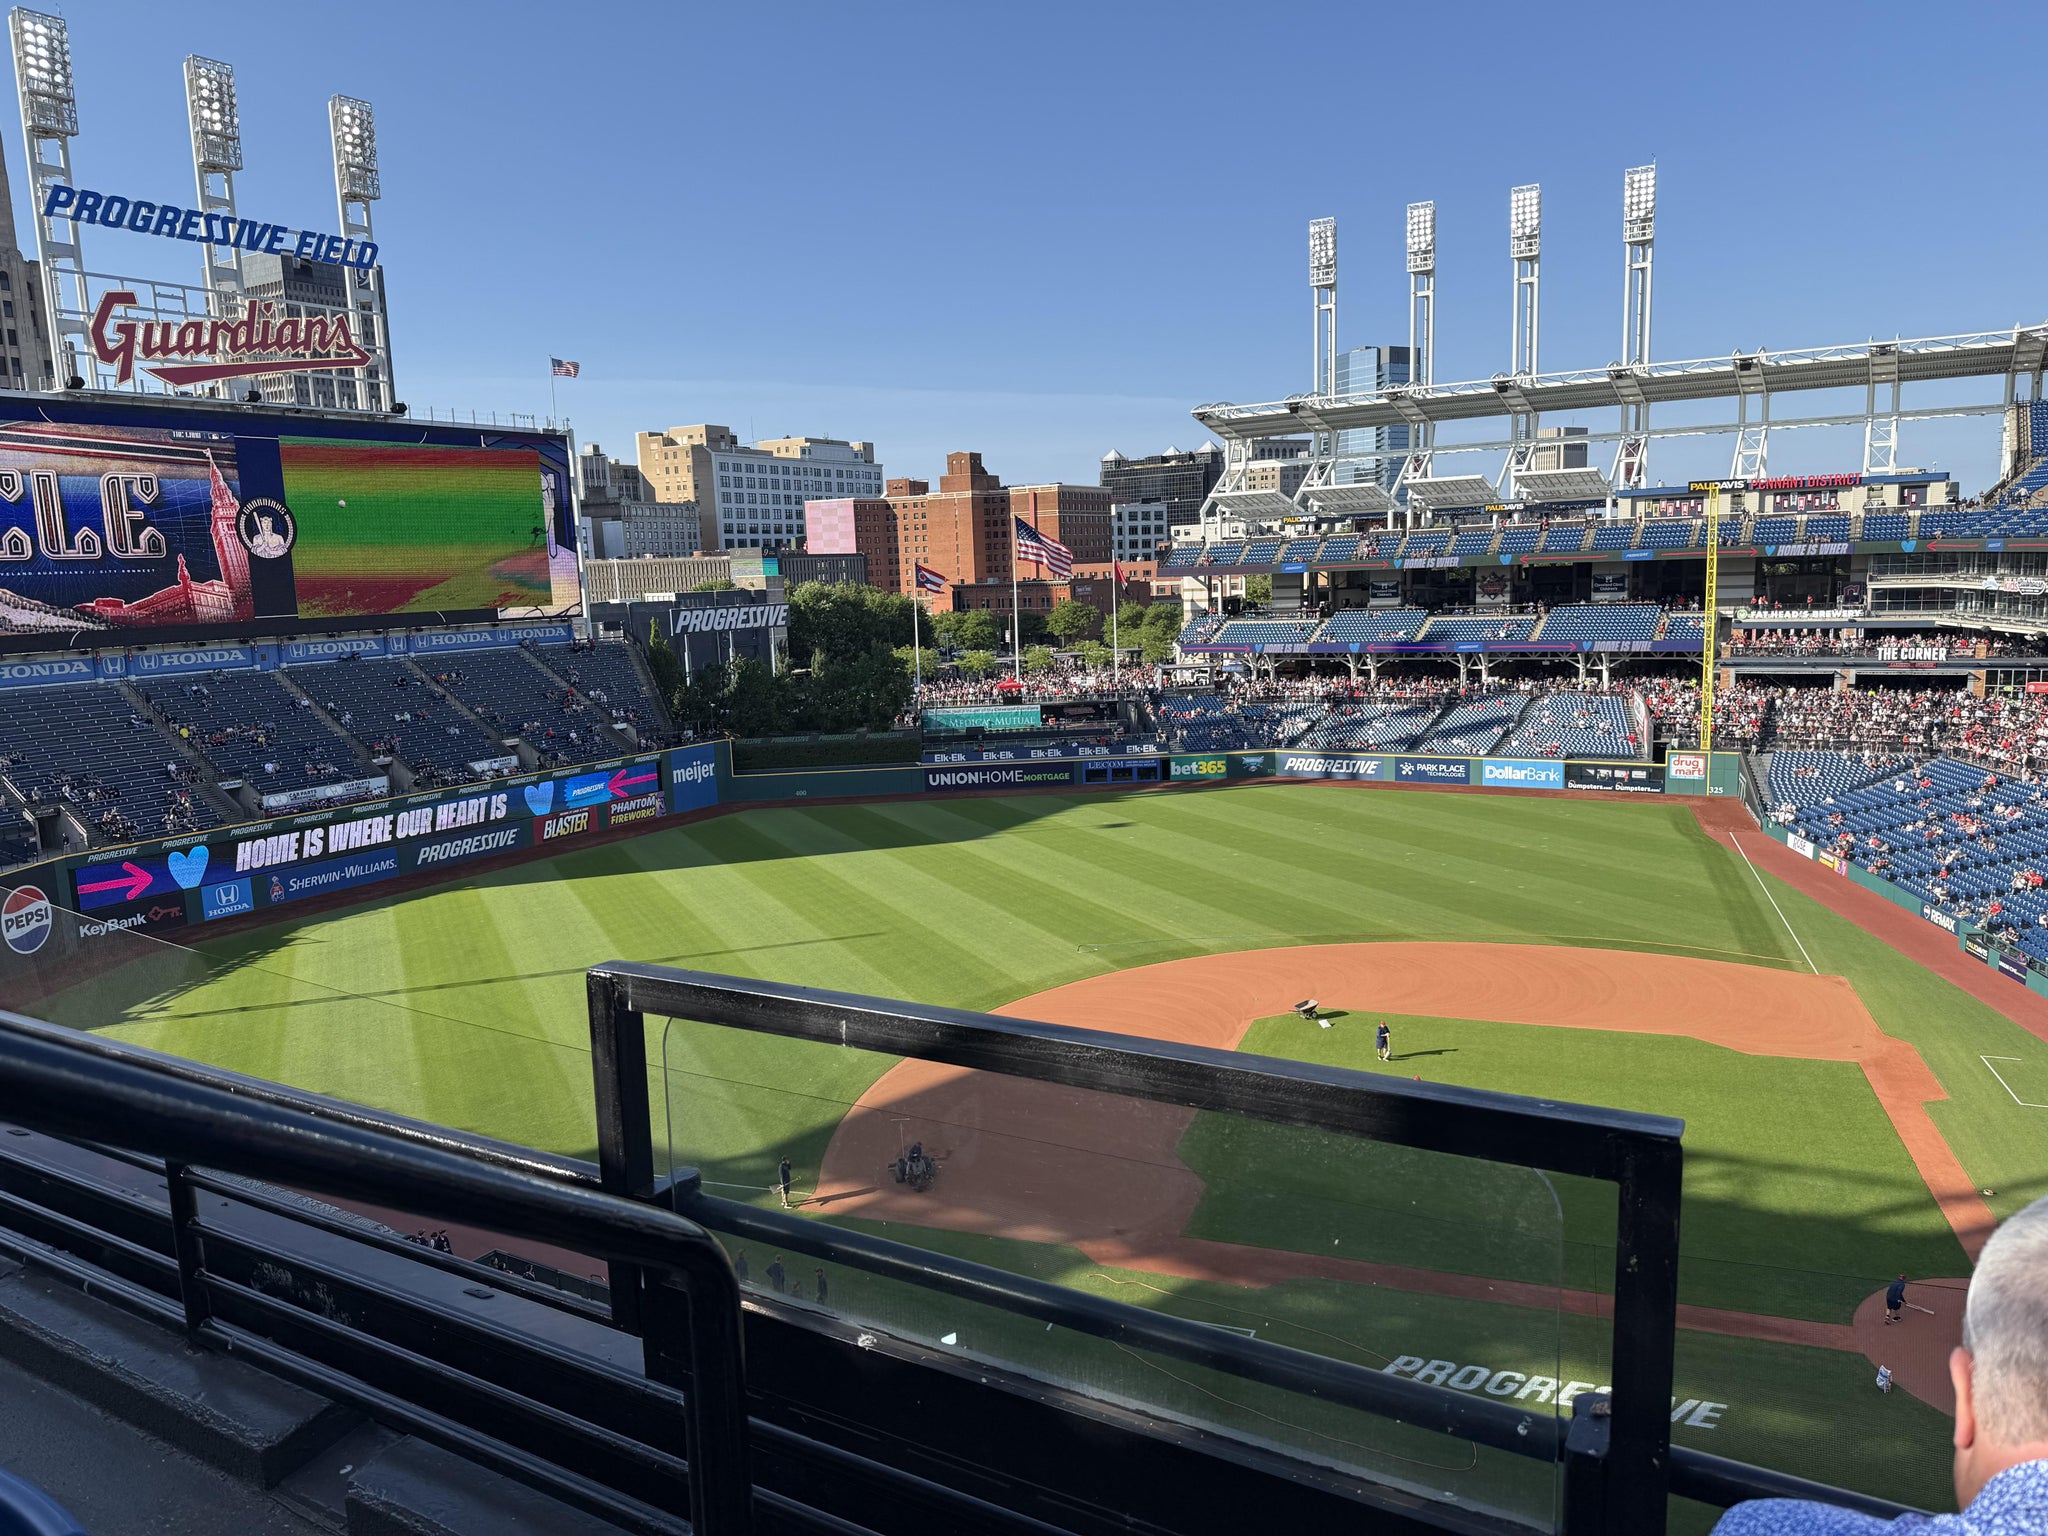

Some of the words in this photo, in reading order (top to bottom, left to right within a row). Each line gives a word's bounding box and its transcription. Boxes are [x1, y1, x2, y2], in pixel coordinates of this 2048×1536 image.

[44, 184, 289, 255] PROGRESSIVE
[294, 230, 379, 270] FIELD
[90, 290, 372, 387] Guardians
[1751, 475, 1805, 490] PENNANT
[1808, 472, 1863, 488] DISTRICT
[1777, 544, 1805, 556] HOME
[1807, 544, 1818, 554] IS
[1404, 558, 1426, 568] HOME
[1427, 558, 1435, 568] IS
[675, 604, 789, 634] PROGRESSIVE
[1751, 610, 1769, 618] FAT
[1770, 610, 1808, 618] HEAD'S
[1812, 610, 1862, 618] BREWERY
[431, 632, 492, 646] HONDA
[511, 626, 567, 640] HONDA
[308, 640, 380, 655] HONDA
[1263, 644, 1283, 652] HOME
[1284, 644, 1292, 652] IS
[1594, 642, 1618, 651] HOME
[1621, 642, 1629, 651] IS
[162, 650, 246, 666] HONDA
[1877, 648, 1898, 660] THE
[1900, 647, 1947, 661] CORNER
[994, 716, 1034, 726] MUTUAL
[594, 760, 624, 770] PROGRESSIVE
[634, 754, 662, 764] PROGRESSIVE
[1088, 760, 1124, 769] LECOM
[1673, 756, 1699, 769] drug
[552, 767, 582, 778] PROGRESSIVE
[673, 760, 716, 785] meijer
[1170, 760, 1226, 776] bet365
[1284, 758, 1379, 775] PROGRESSIVE
[1416, 764, 1438, 772] PARK
[1439, 764, 1466, 772] PLACE
[1675, 767, 1705, 776] mart
[507, 775, 539, 786] PROGRESSIVE
[1024, 772, 1070, 782] MORTGAGE
[458, 782, 492, 796] PROGRESSIVE
[572, 782, 606, 796] PROGRESSIVE
[1710, 786, 1724, 794] 325
[408, 792, 443, 804] PROGRESSIVE
[610, 796, 656, 814] PHANTOM
[352, 802, 391, 815] PROGRESSIVE
[293, 811, 334, 825] PROGRESSIVE
[610, 808, 656, 824] FIREWORKS
[230, 822, 274, 838] PROGRESSIVE
[236, 832, 299, 872] HOME
[304, 828, 325, 857] IS
[329, 817, 392, 851] WHERE
[396, 808, 432, 840] OUR
[436, 798, 490, 832] HEART
[491, 793, 508, 820] IS
[544, 812, 588, 840] BLASTER
[162, 834, 208, 850] PROGRESSIVE
[418, 828, 518, 865] PROGRESSIVE
[88, 846, 139, 862] PROGRESSIVE
[208, 902, 250, 918] HONDA
[4, 906, 50, 932] PEPSI
[79, 912, 148, 938] KeyBank
[1382, 1355, 1728, 1430] PROGREVE
